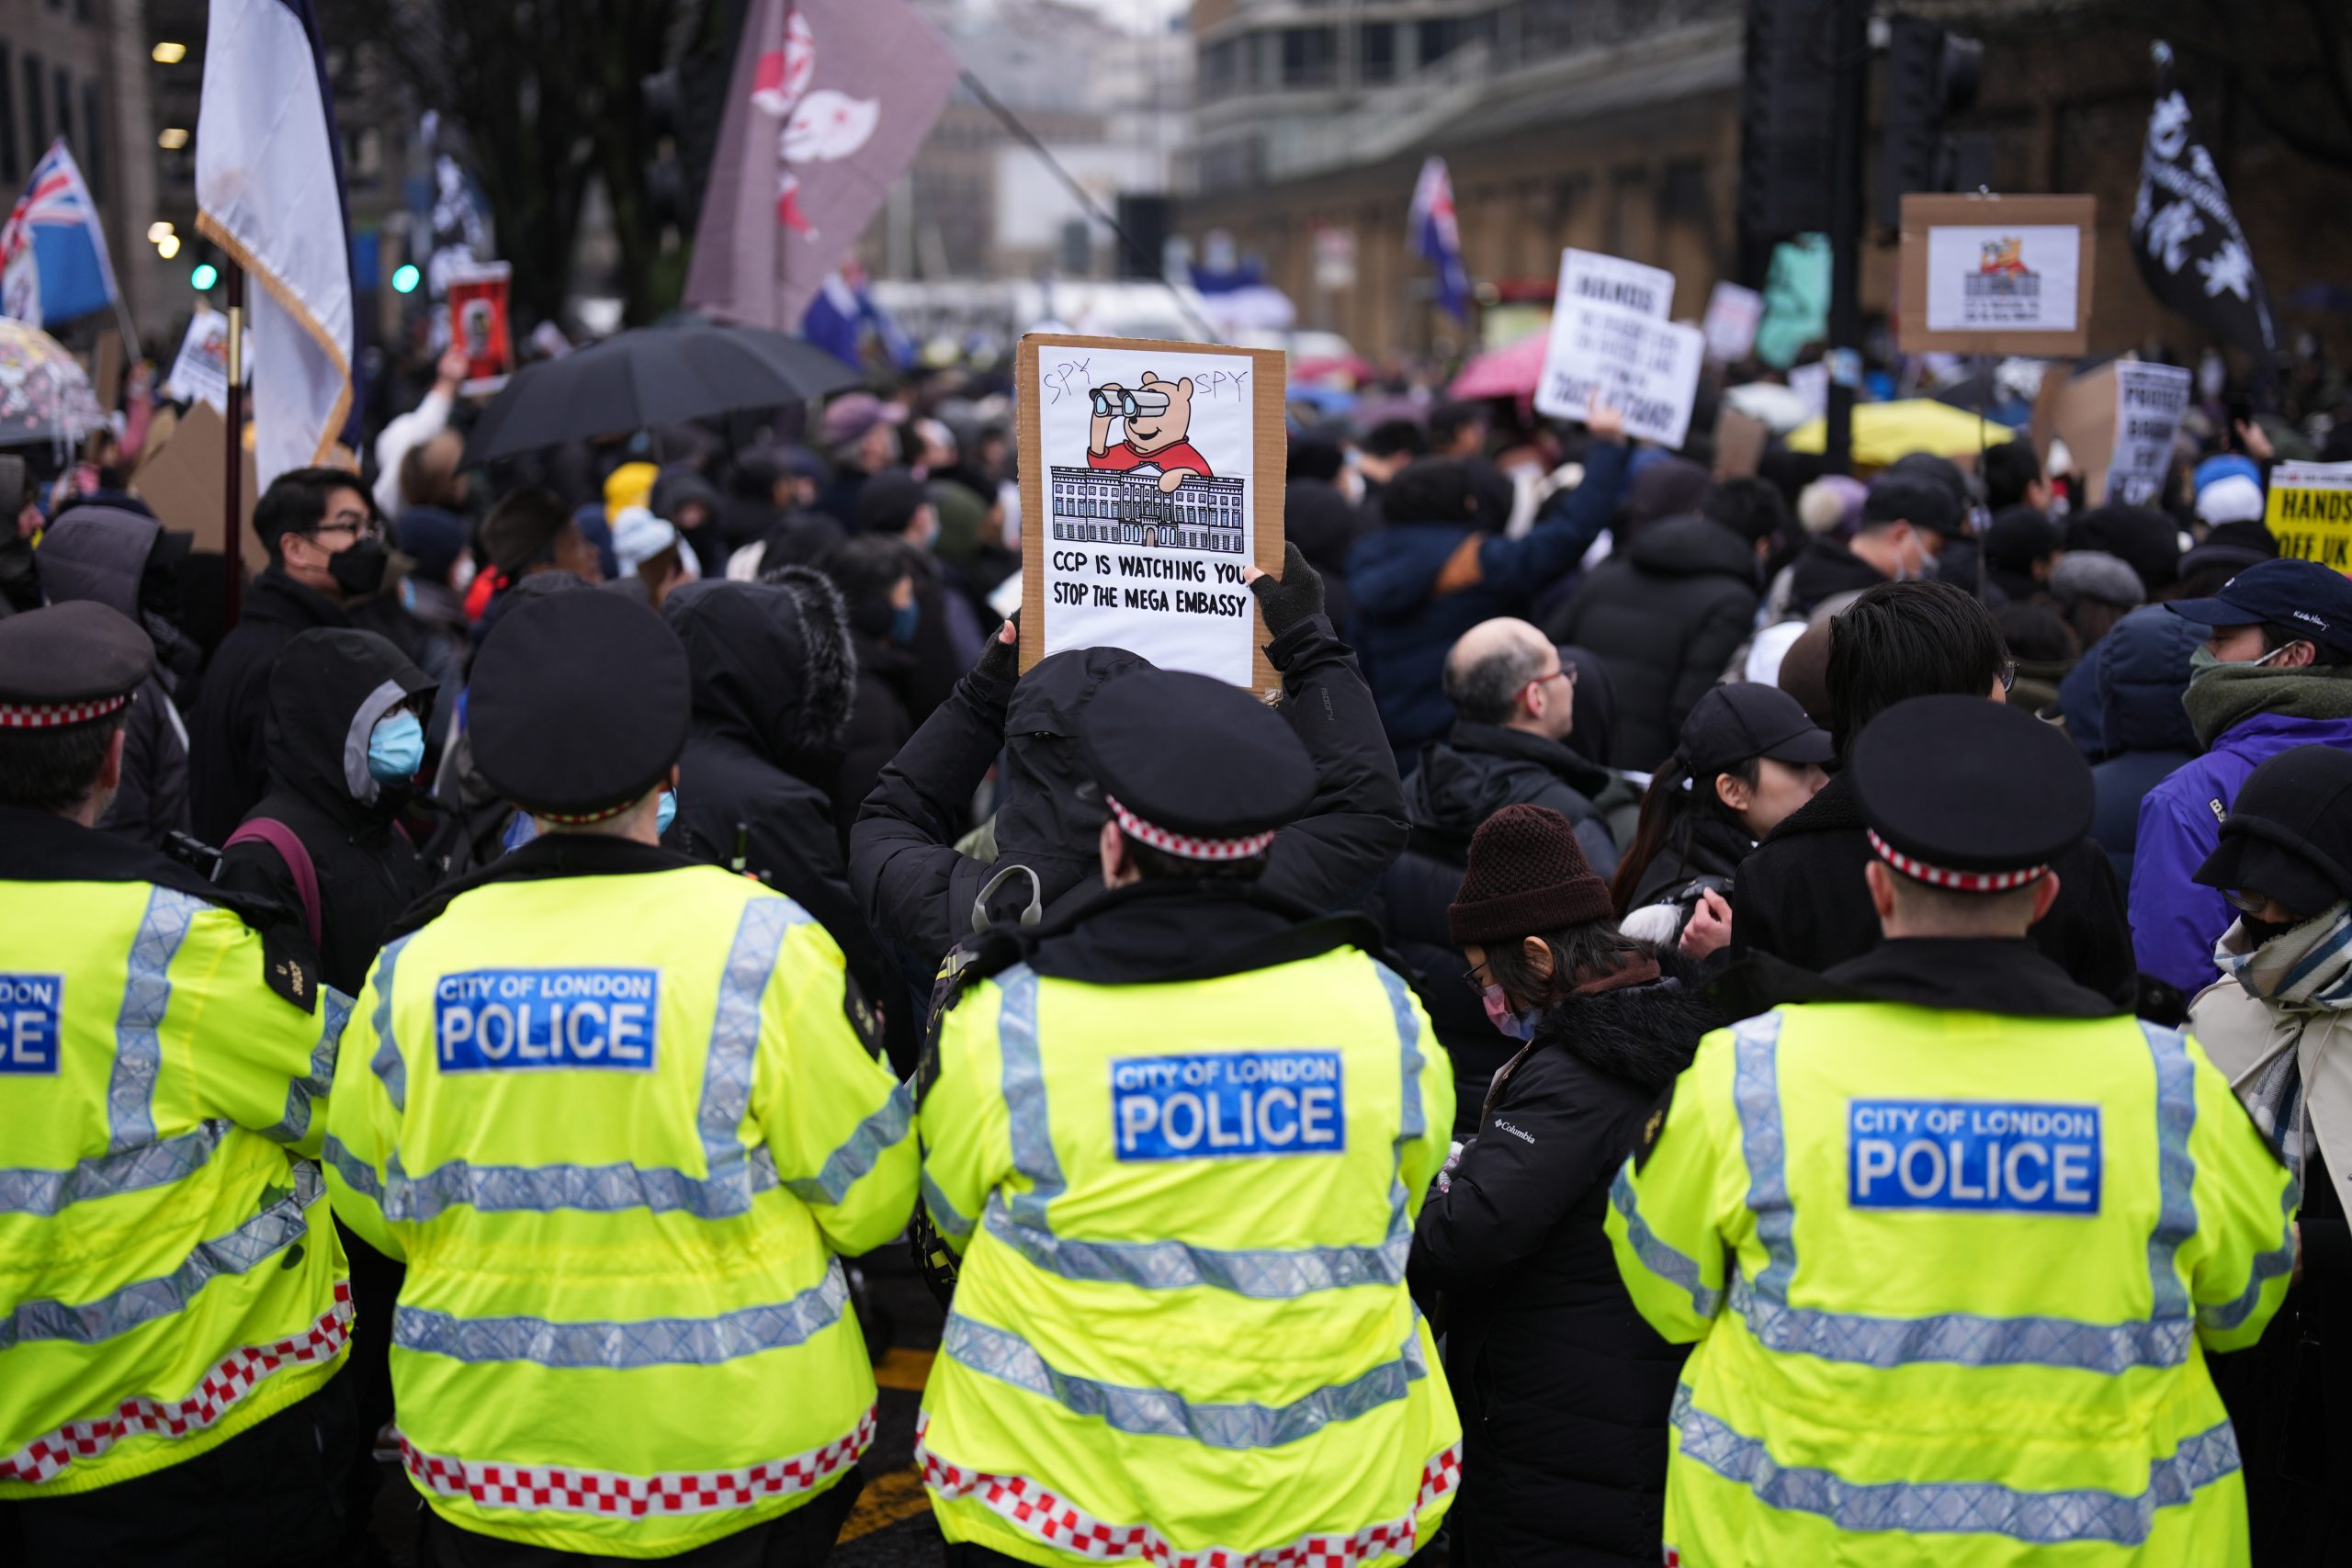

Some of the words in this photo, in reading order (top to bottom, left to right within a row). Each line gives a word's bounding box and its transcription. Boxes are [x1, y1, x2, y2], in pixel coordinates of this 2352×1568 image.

[1044, 358, 1092, 404] SPY
[1194, 370, 1249, 402] SPY
[2282, 491, 2352, 524] HANDS
[1053, 550, 1087, 572] CCP
[1096, 555, 1111, 575] IS
[1118, 556, 1205, 583] WATCHING
[2278, 533, 2313, 560] OFF
[2322, 536, 2349, 568] UK
[1054, 582, 1088, 606] STOP
[1092, 584, 1118, 608] THE
[1125, 587, 1169, 612] MEGA
[1176, 591, 1247, 618] EMBASSY
[439, 976, 495, 1000] CITY
[499, 976, 537, 998] OF
[540, 975, 651, 998] LONDON
[0, 1010, 47, 1064] E
[442, 1001, 648, 1061] POLICE
[1116, 1063, 1179, 1090] CITY
[1182, 1060, 1221, 1086] OF
[1226, 1056, 1336, 1084] LONDON
[1121, 1087, 1336, 1151] POLICE
[1501, 1121, 1535, 1145] Columbia
[1854, 1108, 1920, 1133] CITY
[1925, 1109, 1966, 1134] OF
[1973, 1110, 2095, 1138] LONDON
[1857, 1138, 2092, 1203] POLICE
